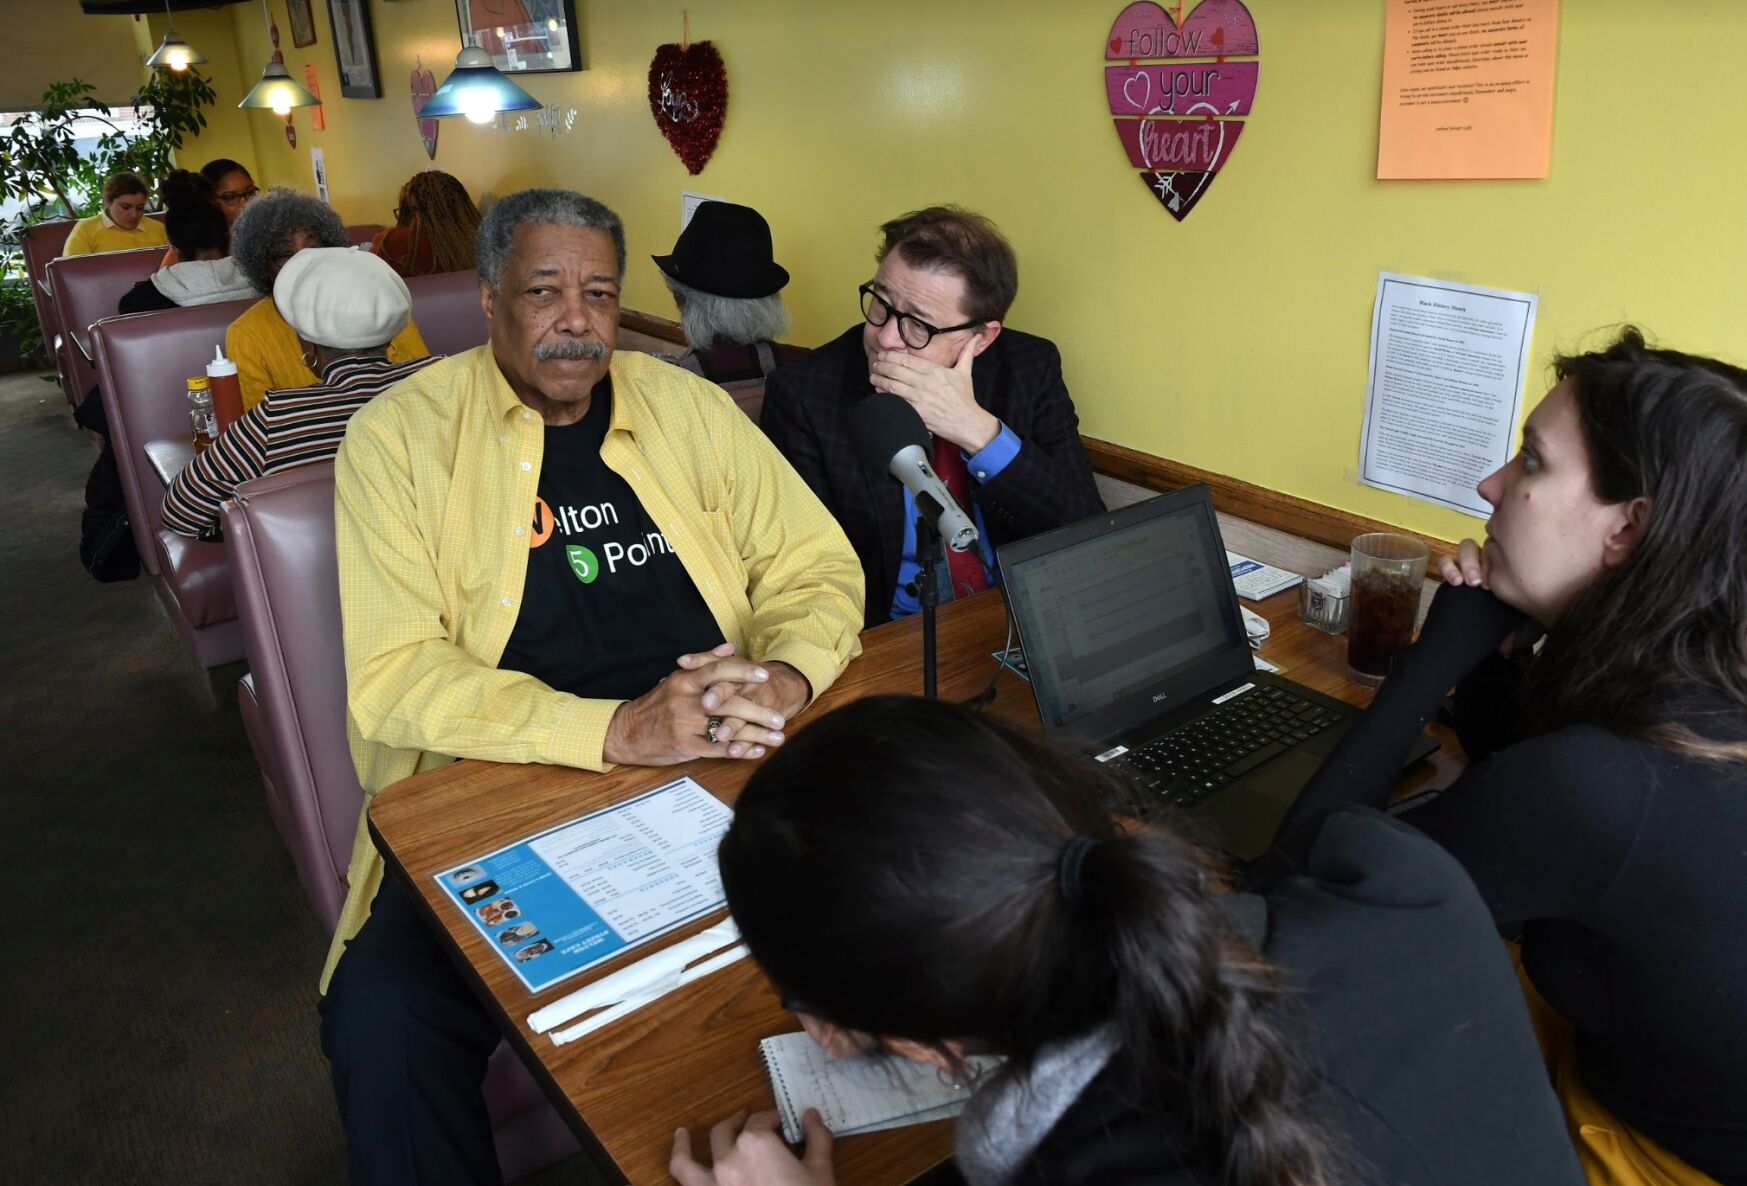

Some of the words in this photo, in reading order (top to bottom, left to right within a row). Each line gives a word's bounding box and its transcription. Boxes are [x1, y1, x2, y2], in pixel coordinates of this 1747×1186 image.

[1128, 28, 1203, 57] follow
[1159, 70, 1221, 111] your
[1143, 120, 1216, 164] heart
[569, 550, 589, 578] 5
